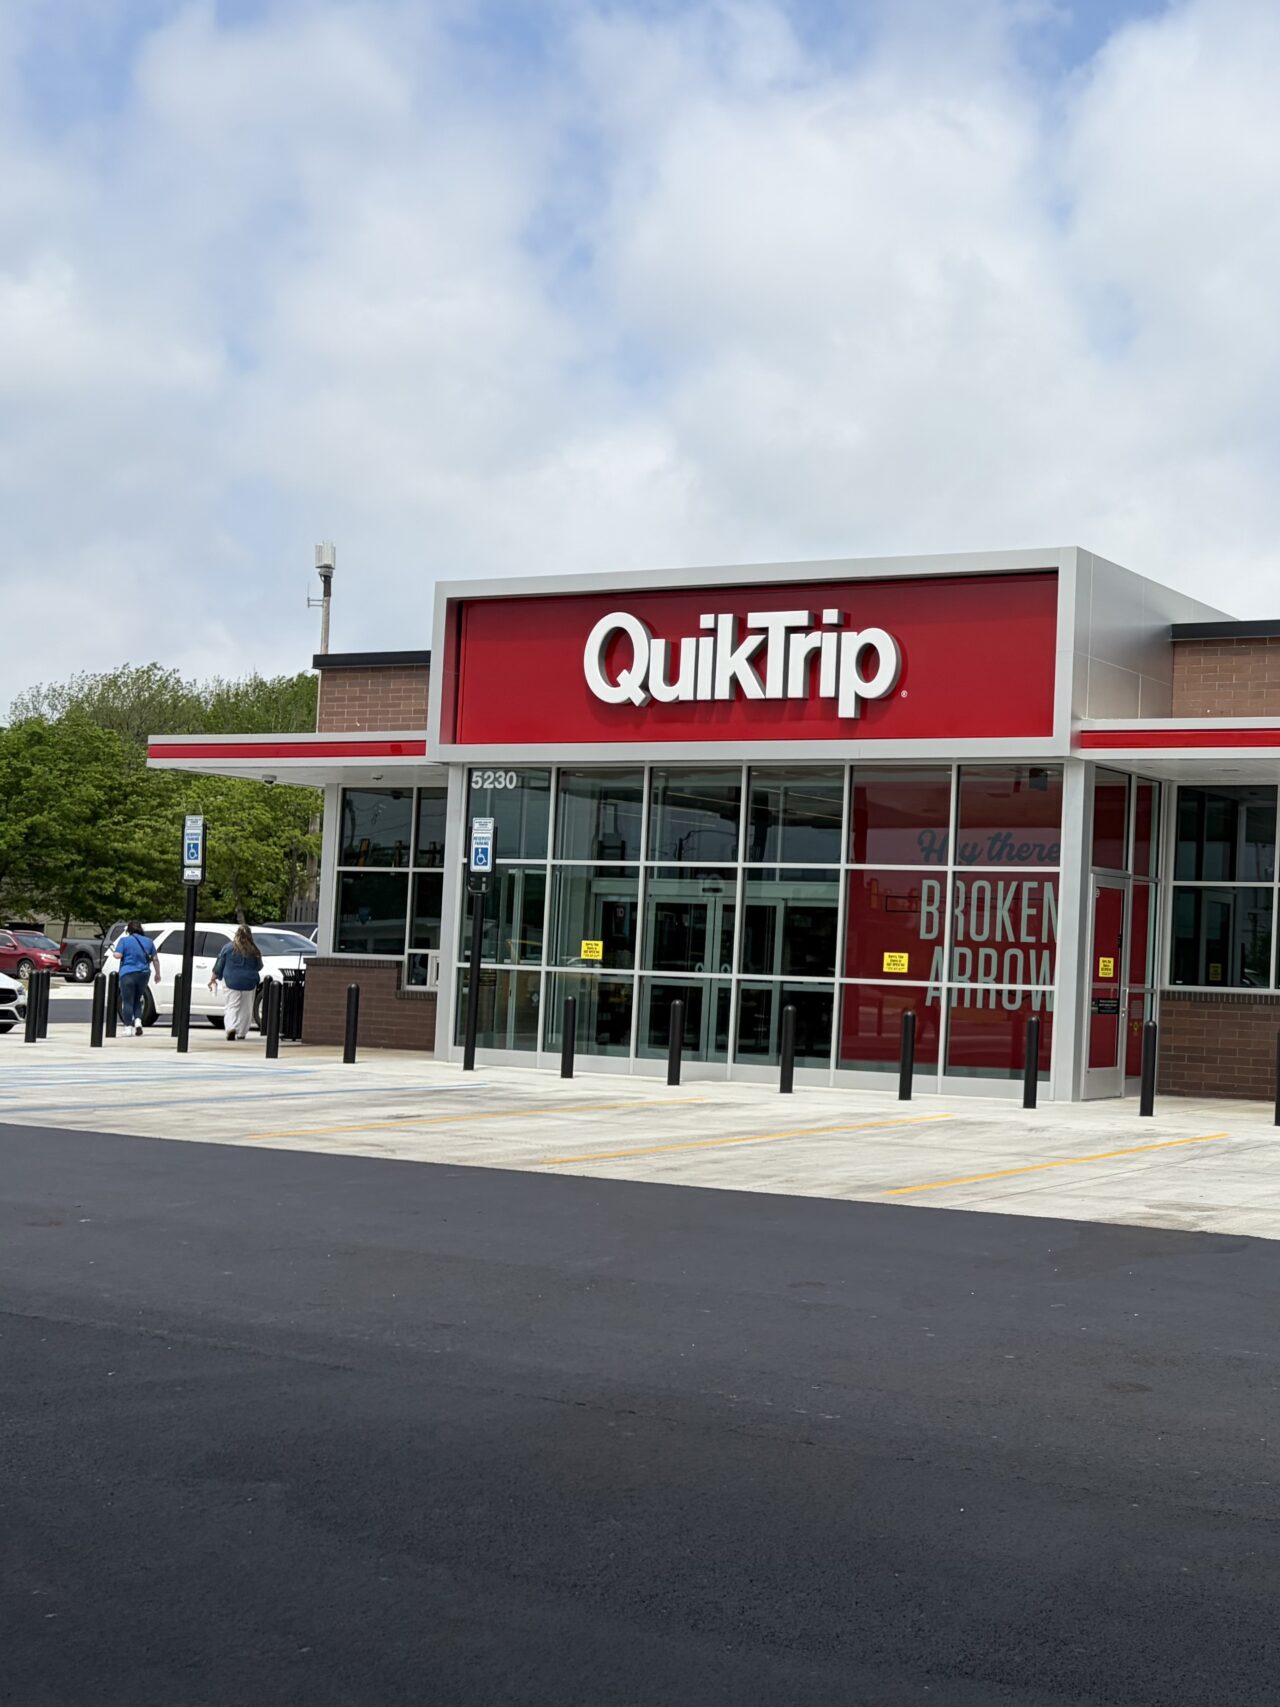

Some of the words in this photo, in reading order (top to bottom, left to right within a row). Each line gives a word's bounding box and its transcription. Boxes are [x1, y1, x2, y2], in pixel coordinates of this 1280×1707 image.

[583, 608, 901, 719] QuikTrip
[471, 771, 517, 789] 5230
[917, 829, 983, 866] Hy
[919, 879, 1060, 943] BROKEN
[925, 945, 1058, 1012] ARROW
